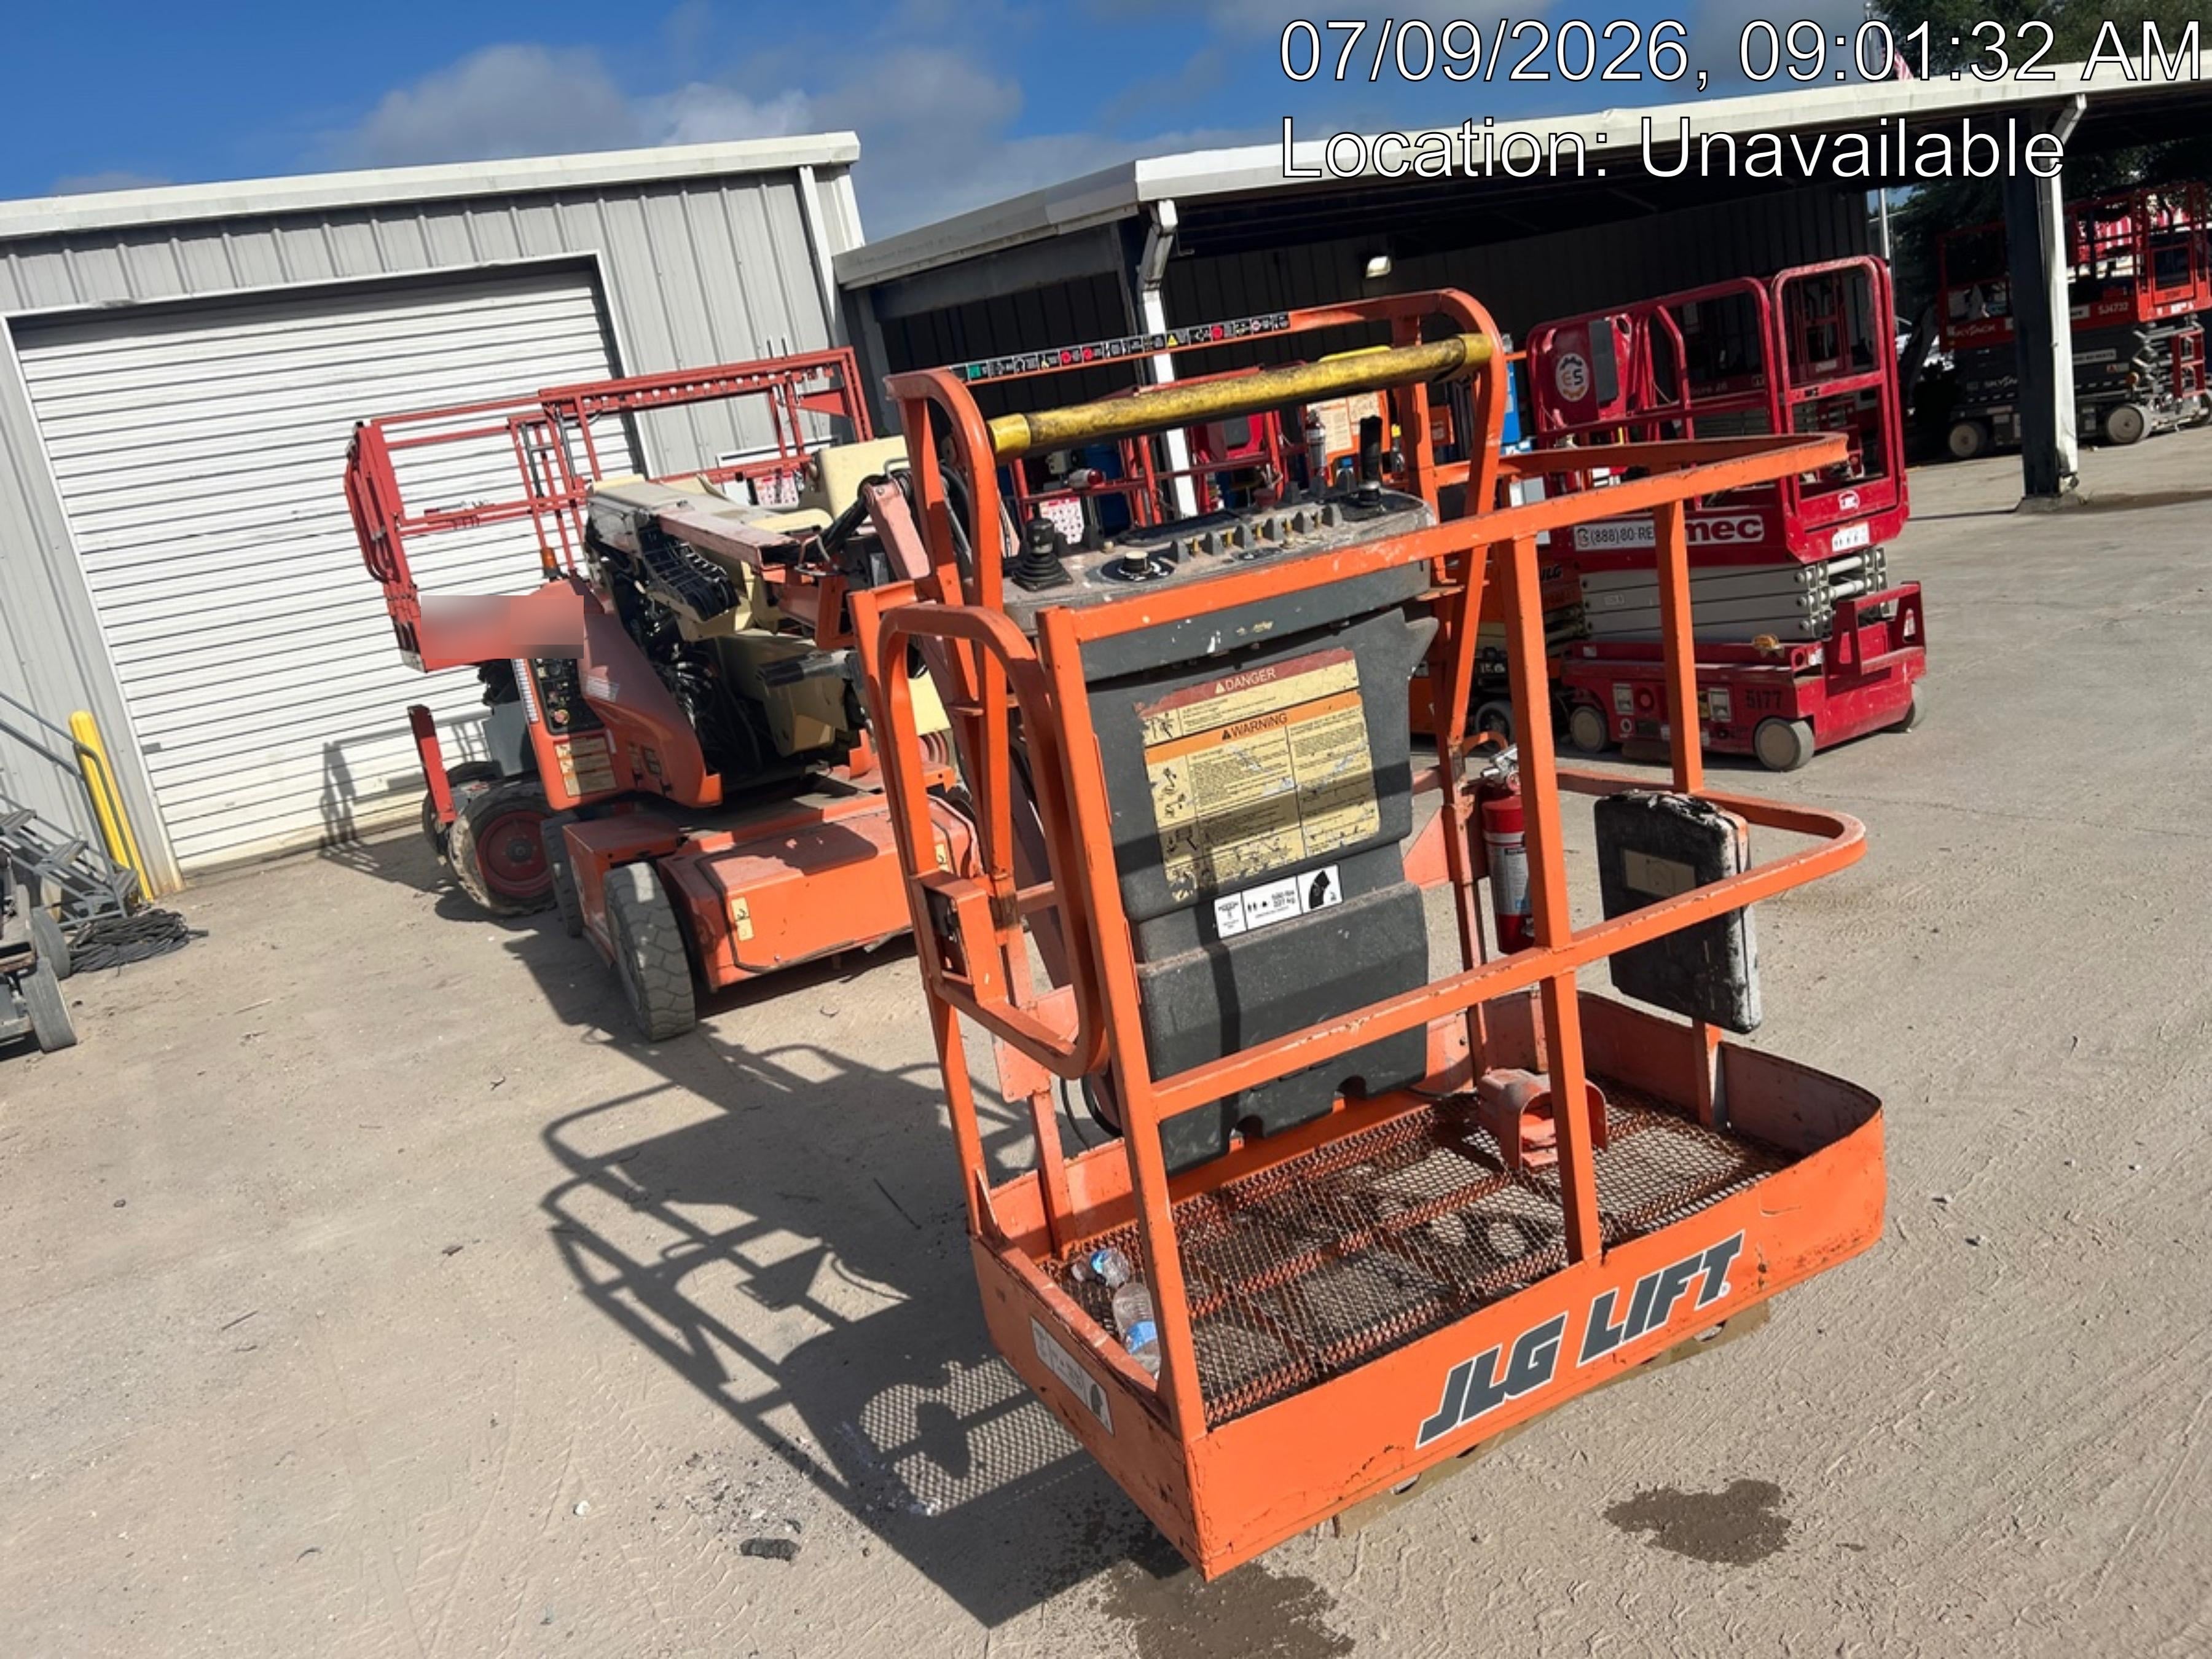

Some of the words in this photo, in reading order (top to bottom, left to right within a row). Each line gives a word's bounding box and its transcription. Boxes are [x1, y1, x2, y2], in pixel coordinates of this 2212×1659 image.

[1225, 667, 1276, 692] DANGER
[1231, 713, 1287, 737] WARNING
[1414, 1311, 1569, 1451] JLG
[1575, 1229, 1746, 1368] LIFT
